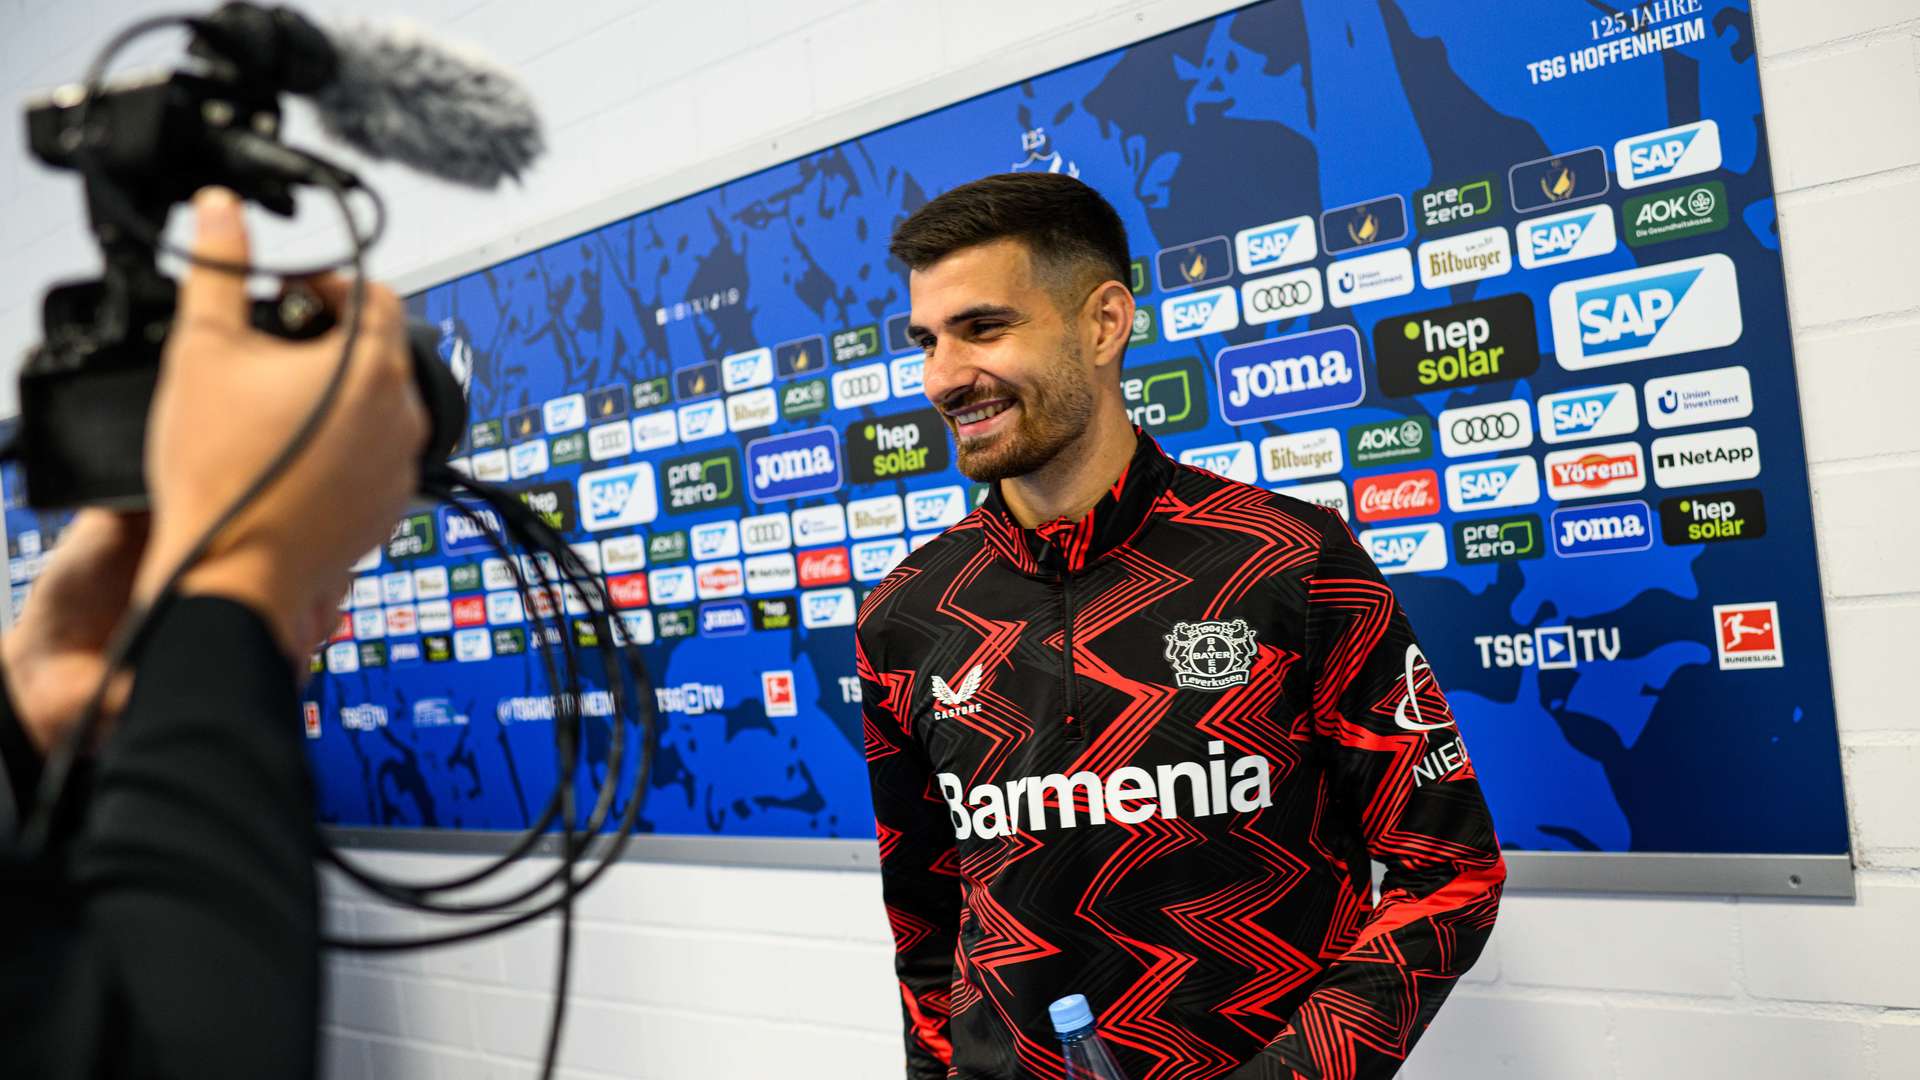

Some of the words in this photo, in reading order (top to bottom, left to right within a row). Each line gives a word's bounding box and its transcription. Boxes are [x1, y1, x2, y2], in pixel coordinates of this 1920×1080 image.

[1590, 12, 1627, 40] 125
[1631, 0, 1703, 33] JAHRE
[1527, 55, 1567, 84] TSG
[1570, 18, 1706, 75] HOFFENHEIM
[1631, 140, 1685, 174] SAP
[1422, 188, 1459, 212] pre
[1635, 196, 1688, 226] AOK
[1424, 202, 1475, 226] zero
[1249, 233, 1289, 262] SAP
[1532, 223, 1582, 254] SAP
[1429, 248, 1502, 279] Bitburger
[1176, 302, 1214, 330] SAP
[1579, 288, 1675, 346] SAP
[1424, 316, 1490, 353] hep
[1418, 346, 1504, 386] solar
[1682, 388, 1710, 401] Union
[1682, 394, 1740, 410] Investment
[1126, 403, 1166, 425] ro
[1554, 400, 1604, 431] SAP
[877, 423, 920, 451] hep
[1358, 427, 1400, 450] AOK
[872, 447, 928, 476] solar
[1270, 447, 1334, 471] Bitburger
[1679, 446, 1754, 467] NetApp
[668, 462, 702, 487] pre
[1555, 457, 1635, 484] Yörem
[671, 482, 717, 507] zero
[1460, 471, 1508, 500] SAP
[1692, 500, 1736, 521] hep
[1463, 523, 1500, 543] pre
[1688, 517, 1745, 540] solar
[1374, 539, 1417, 564] SAP
[1465, 540, 1516, 559] zero
[1200, 625, 1221, 633] 1904
[1193, 651, 1231, 660] BAYER
[1207, 637, 1218, 674] BAYER
[1474, 633, 1534, 669] TSG
[1576, 627, 1621, 662] TV
[1724, 654, 1777, 665] BUNDESLIGA
[1182, 674, 1243, 687] Leverkusen
[934, 703, 982, 721] CASTORE
[937, 740, 1274, 841] Barmenia
